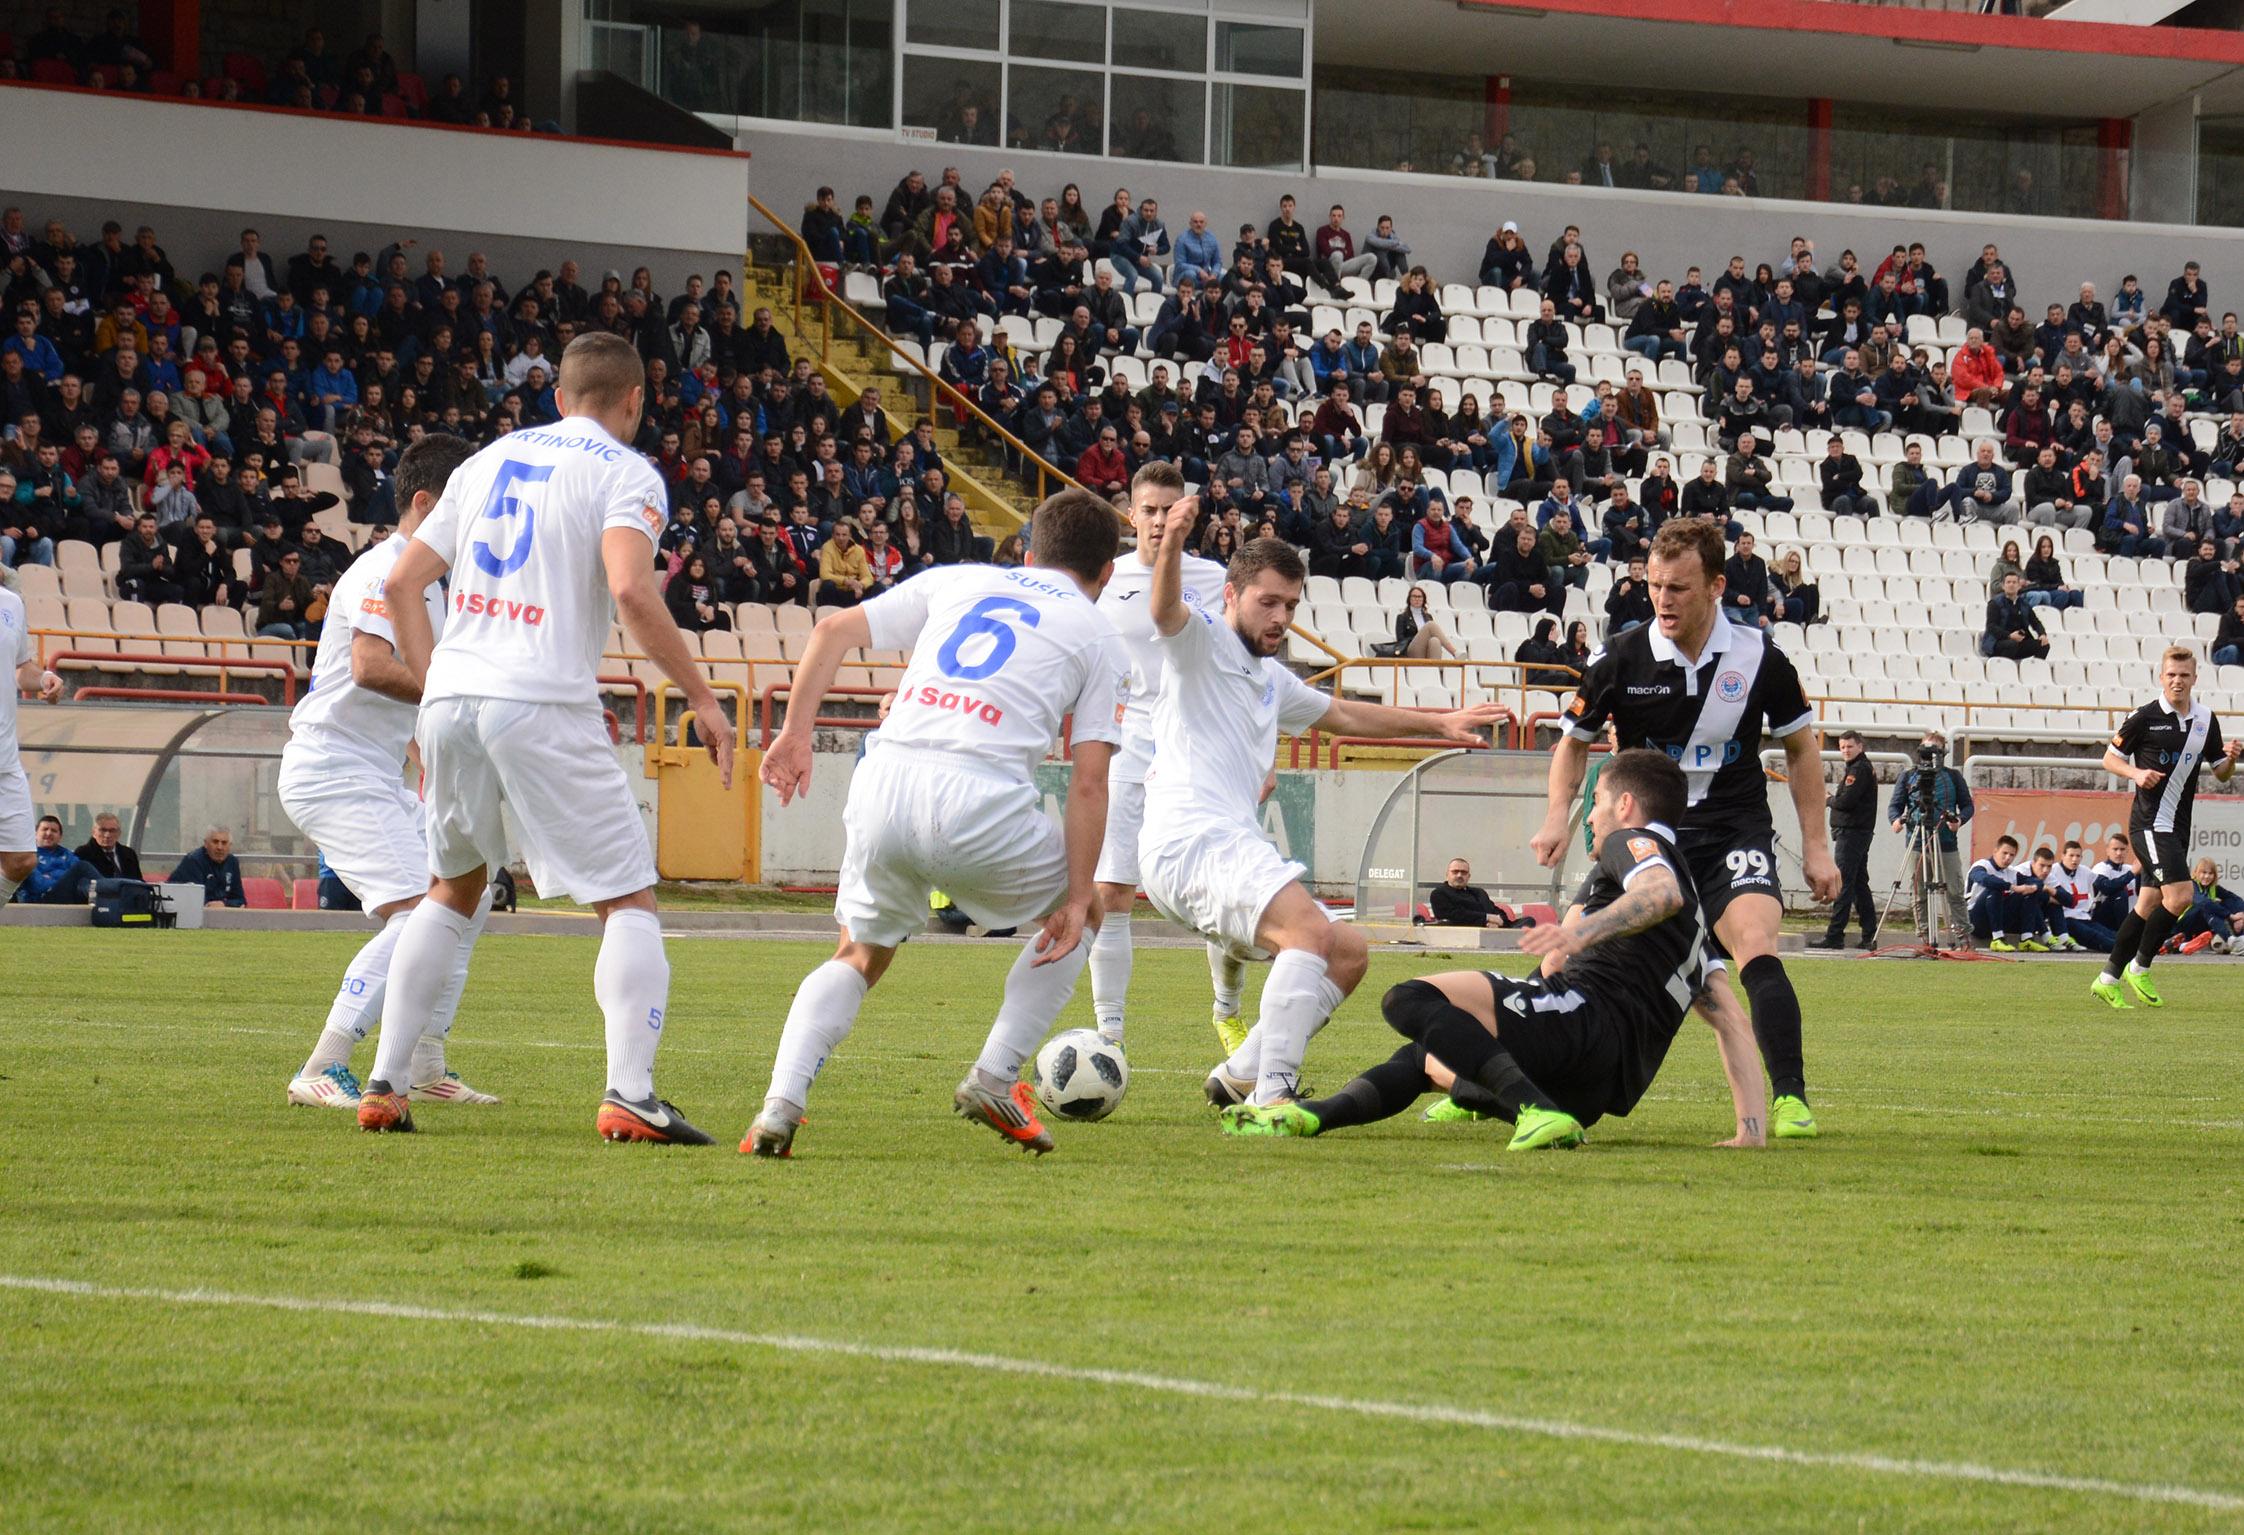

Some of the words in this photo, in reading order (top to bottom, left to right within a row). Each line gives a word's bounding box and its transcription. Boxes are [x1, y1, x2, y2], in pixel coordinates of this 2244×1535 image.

[472, 459, 556, 579] 5
[466, 593, 545, 627] sava
[936, 596, 1041, 681] 6
[1626, 685, 1671, 695] macron
[917, 686, 1004, 728] sava
[2190, 824, 2242, 852] jemo
[1368, 868, 1406, 879] DELEGAT
[1726, 849, 1770, 881] 99
[1730, 876, 1772, 889] macron
[647, 1007, 663, 1031] 5
